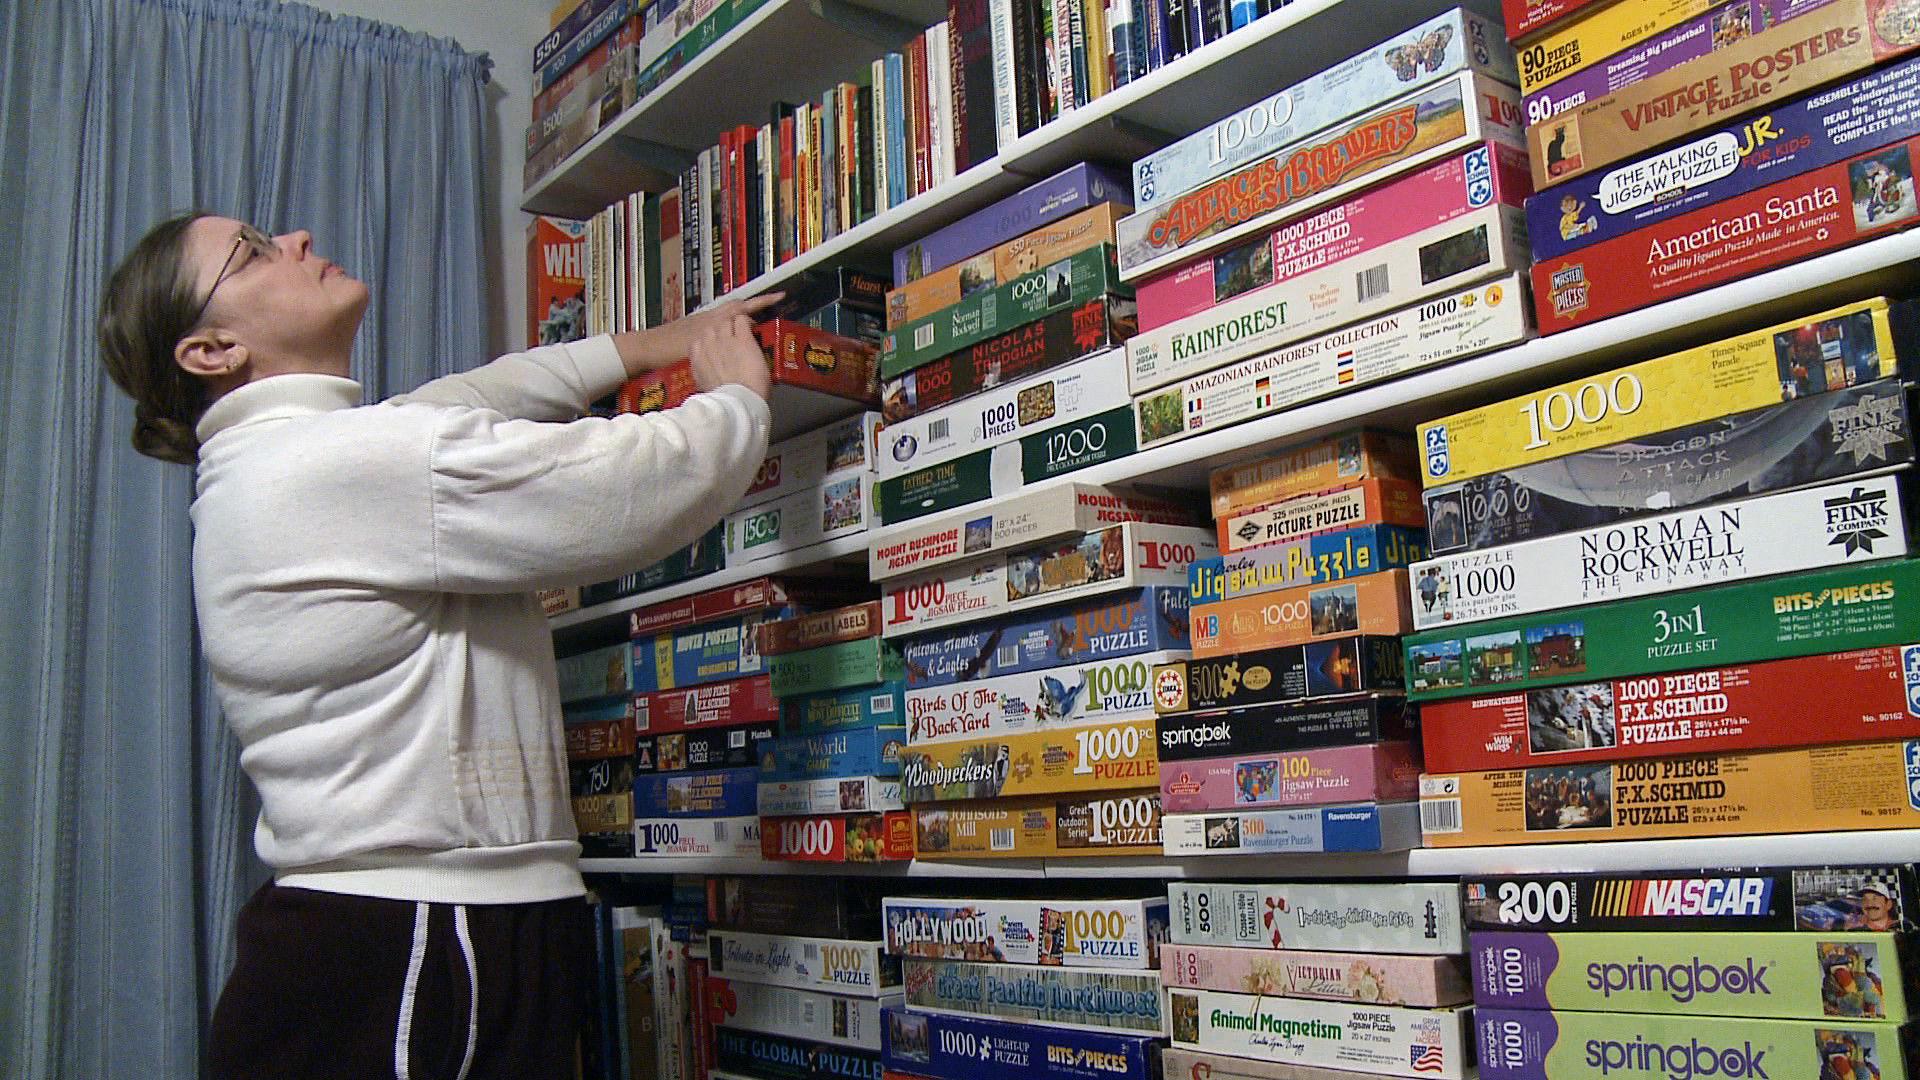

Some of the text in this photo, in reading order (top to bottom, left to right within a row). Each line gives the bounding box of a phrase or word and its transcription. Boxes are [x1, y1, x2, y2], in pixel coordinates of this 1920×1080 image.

[593, 10, 619, 41] GLORY
[536, 32, 560, 66] 550
[1522, 39, 1580, 74] 90 PIECE
[1607, 23, 1706, 75] Dreaming Basketball
[1525, 52, 1582, 87] PUZZLE
[1620, 75, 1723, 132] VINTAGE
[1729, 26, 1861, 93] POSTERS
[1706, 80, 1772, 116] Puzzle
[1807, 78, 1879, 111] ASSEMBLE the
[1852, 74, 1917, 105] windows and
[1528, 90, 1586, 126] 90 PIECE
[1852, 103, 1869, 116] the
[1877, 107, 1894, 119] the
[1208, 93, 1294, 168] 1000
[1833, 118, 1888, 145] COMPLETE
[1606, 150, 1737, 208] JIGSAW PUZZLE!
[1614, 141, 1719, 188] THE TALKING
[690, 202, 699, 249] FREEDOM
[1277, 205, 1345, 245] 1000 PIECE
[1646, 210, 1763, 265] American
[1765, 184, 1840, 225] Santa
[1277, 250, 1327, 281] PUZZLE
[1650, 237, 1754, 278] A Quality Jigsaw Puzzle
[1011, 274, 1046, 301] 1000
[952, 308, 980, 326] Norman
[1419, 298, 1457, 323] 1000
[951, 320, 980, 339] Rockwell
[972, 322, 1045, 361] NICOLAS
[1171, 301, 1288, 362] RAINFOREST
[1188, 364, 1253, 394] AMAZONIAN
[1253, 342, 1321, 374] RAINFOREST
[1324, 318, 1400, 351] COLLECTION
[1736, 336, 1767, 355] Square
[917, 370, 952, 393] 1000
[981, 402, 1015, 440] 1000
[1519, 372, 1644, 451] 1000
[987, 420, 1016, 439] PIECES
[1047, 422, 1106, 465] 1200
[1273, 495, 1351, 521] 325 INTERLOCKING PIECES
[1465, 485, 1530, 524] 1000
[1826, 500, 1889, 526] FINK
[1266, 503, 1360, 539] PICTURE PUZZLE
[1580, 507, 1743, 558] NORMAN
[1836, 516, 1889, 532] COMPANY
[877, 528, 959, 561] MOUNT RUSHMORE
[888, 542, 958, 571] JIGSAW PUZZLE
[1138, 541, 1195, 570] 1000
[1582, 531, 1745, 580] ROCKWELL
[1191, 536, 1370, 602] Jigsaw Puzzle
[1451, 550, 1514, 571] PUZZLE
[1582, 553, 1745, 592] THE RUNAWAY
[1453, 564, 1516, 600] 1000
[1773, 580, 1895, 614] BITS PIECES
[887, 577, 967, 625] 1000 PIECE
[927, 595, 987, 618] JIGSAW PUZZLE
[1260, 600, 1308, 624] 1000
[1090, 629, 1149, 654] PUZZLE
[1195, 614, 1219, 639] MB
[1648, 638, 1718, 659] PUZZLE SET
[927, 654, 969, 675] & Eagles
[1085, 660, 1147, 712] 1000
[1619, 671, 1720, 701] 1000 PIECE
[907, 688, 998, 719] Birds Of The
[1620, 693, 1728, 723] F.X.SCHMID
[922, 711, 991, 739] Back Yard
[1162, 721, 1232, 749] springbok
[1621, 720, 1692, 745] PUZZLE
[689, 741, 709, 752] 1000
[689, 752, 708, 763] PUZZLE
[808, 735, 847, 756] World
[1073, 725, 1154, 776] 1000 PC
[588, 760, 610, 793] 750
[904, 756, 994, 790] Woodpeckers
[1094, 760, 1156, 780] PUZZLE
[1282, 756, 1332, 777] 100 Piece
[1617, 758, 1719, 782] 1000 PIECE
[1282, 775, 1350, 795] Jigsaw Puzzle
[1615, 778, 1726, 804] F.X.SCHMID
[1058, 816, 1088, 828] Outdoors
[1069, 805, 1088, 816] Great
[1088, 797, 1152, 843] 1000
[1328, 811, 1371, 821] Ravensburger
[1616, 804, 1690, 826] PUZZLE
[639, 823, 679, 853] 1000
[779, 819, 834, 856] 1000
[956, 821, 976, 838] Mill
[1068, 827, 1088, 838] Series
[1242, 818, 1265, 836] 500
[1499, 881, 1571, 923] 200
[1643, 878, 1765, 916] NASCAR
[1198, 893, 1211, 933] 500
[894, 915, 988, 948] HOLLYWOOD
[1063, 910, 1125, 952] 1000
[820, 944, 862, 980] 1000
[1080, 940, 1139, 958] PUZZLE
[833, 971, 871, 986] PUZZLE
[1187, 953, 1198, 985] 500
[1287, 964, 1342, 992] VICTORIAN
[1486, 946, 1497, 996] springbok
[1503, 947, 1524, 997] 1000
[1586, 955, 1772, 1002] springbok
[1210, 1008, 1342, 1041] Animal Magnetism
[1368, 1013, 1391, 1023] PIECE
[752, 1038, 808, 1066] GLOBAL
[819, 1054, 883, 1080] PUZZLE
[939, 1029, 1030, 1058] 1000 LIGHT-UP
[993, 1050, 1030, 1067] PUZZLE
[1047, 1044, 1128, 1073] BITS PIECES
[1486, 1019, 1497, 1068] springbok
[1503, 1021, 1524, 1070] 1000
[1585, 1035, 1774, 1080] springbok
